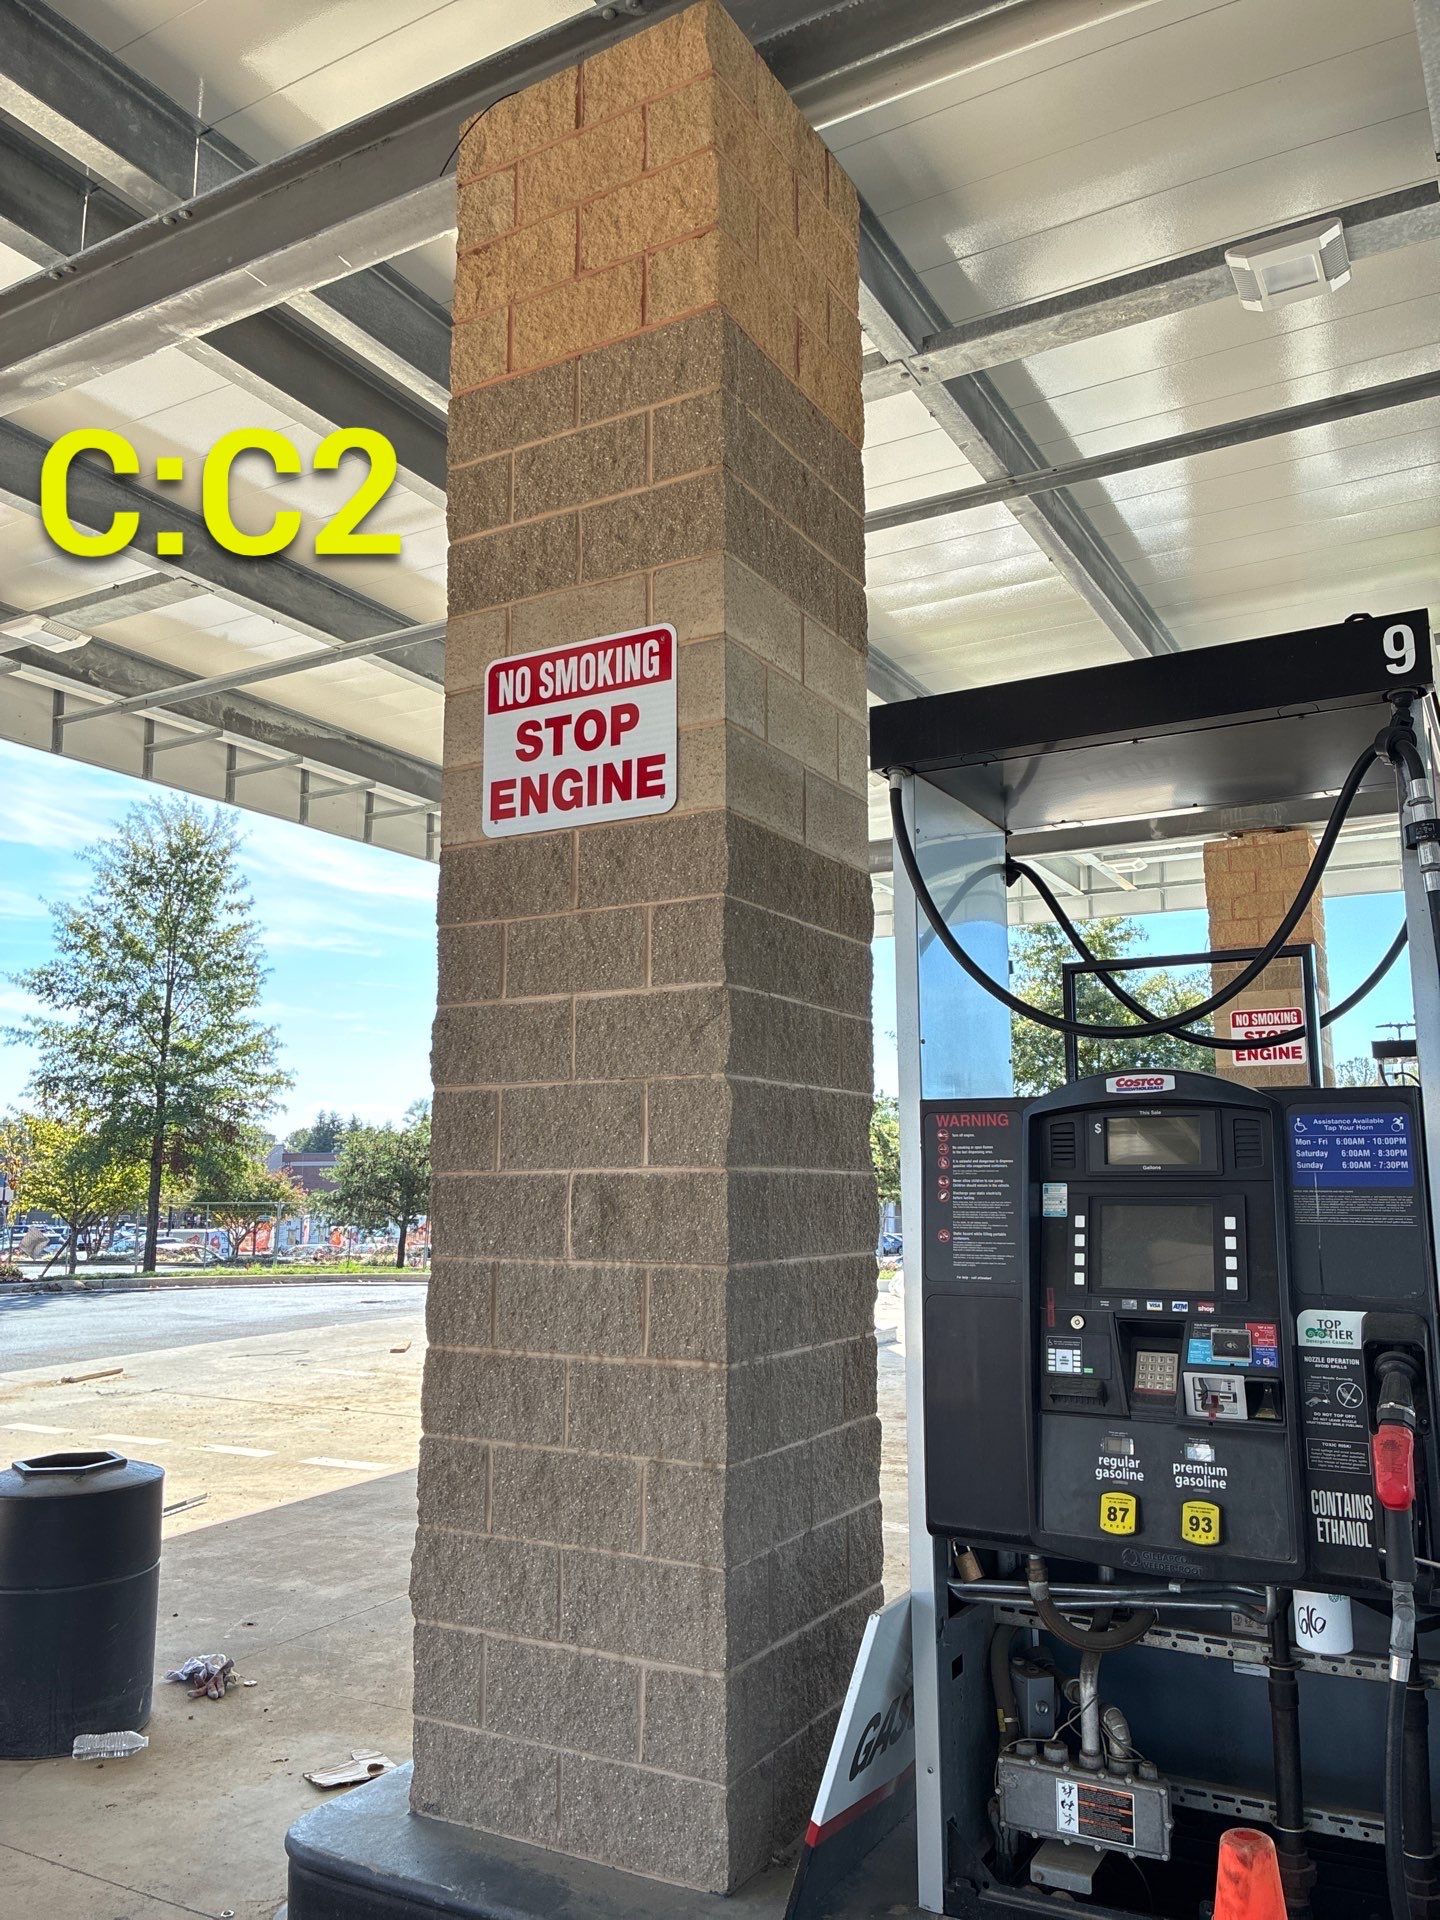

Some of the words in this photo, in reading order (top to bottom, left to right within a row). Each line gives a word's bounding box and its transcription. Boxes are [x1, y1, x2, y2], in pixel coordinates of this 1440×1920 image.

[1383, 624, 1416, 675] 9
[498, 665, 532, 707] NO
[538, 638, 660, 700] SMOKING
[515, 702, 640, 762] STOP
[490, 753, 666, 822] ENGINE
[1235, 1013, 1249, 1026] NO
[1252, 1011, 1298, 1025] SMOKING
[1235, 1046, 1302, 1062] ENGINE
[1116, 1077, 1164, 1087] COSTCO
[936, 1113, 1009, 1127] WARNING
[1094, 1123, 1102, 1134] $
[1198, 1306, 1215, 1314] shop
[1317, 1319, 1341, 1329] TOP
[1328, 1330, 1353, 1340] TIER
[1326, 1357, 1360, 1365] OPERATION
[1098, 1456, 1141, 1469] regular
[1095, 1468, 1144, 1481] gasoline
[1173, 1463, 1228, 1477] premium
[1175, 1476, 1227, 1489] gasoline
[1310, 1490, 1374, 1520] CONTAINS
[1107, 1506, 1130, 1522] 87
[1189, 1516, 1212, 1534] 93
[1316, 1518, 1372, 1548] ETHANOL
